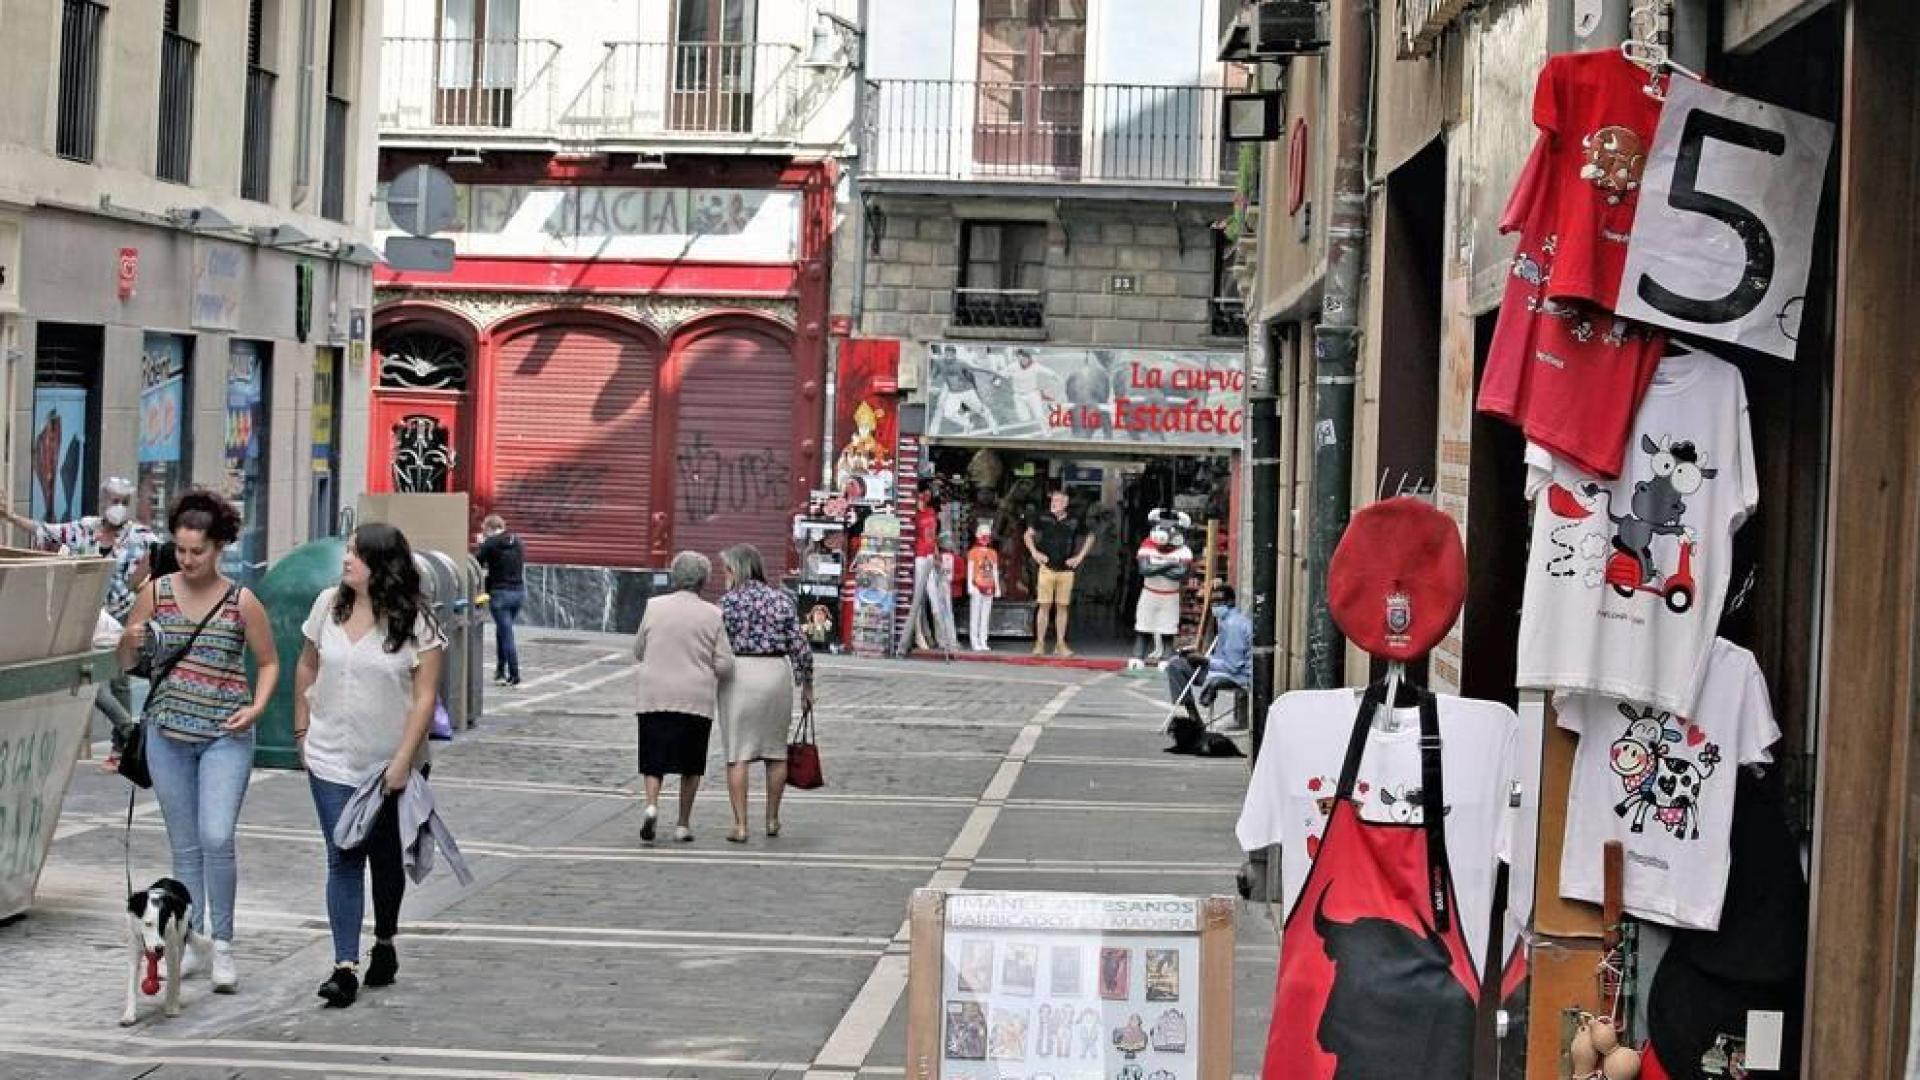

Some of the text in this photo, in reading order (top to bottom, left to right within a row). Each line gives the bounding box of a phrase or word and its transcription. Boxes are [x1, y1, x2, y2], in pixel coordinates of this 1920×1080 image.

[1637, 107, 1786, 325] 5
[1130, 361, 1163, 389] La
[1048, 404, 1073, 428] de
[1080, 404, 1102, 429] la
